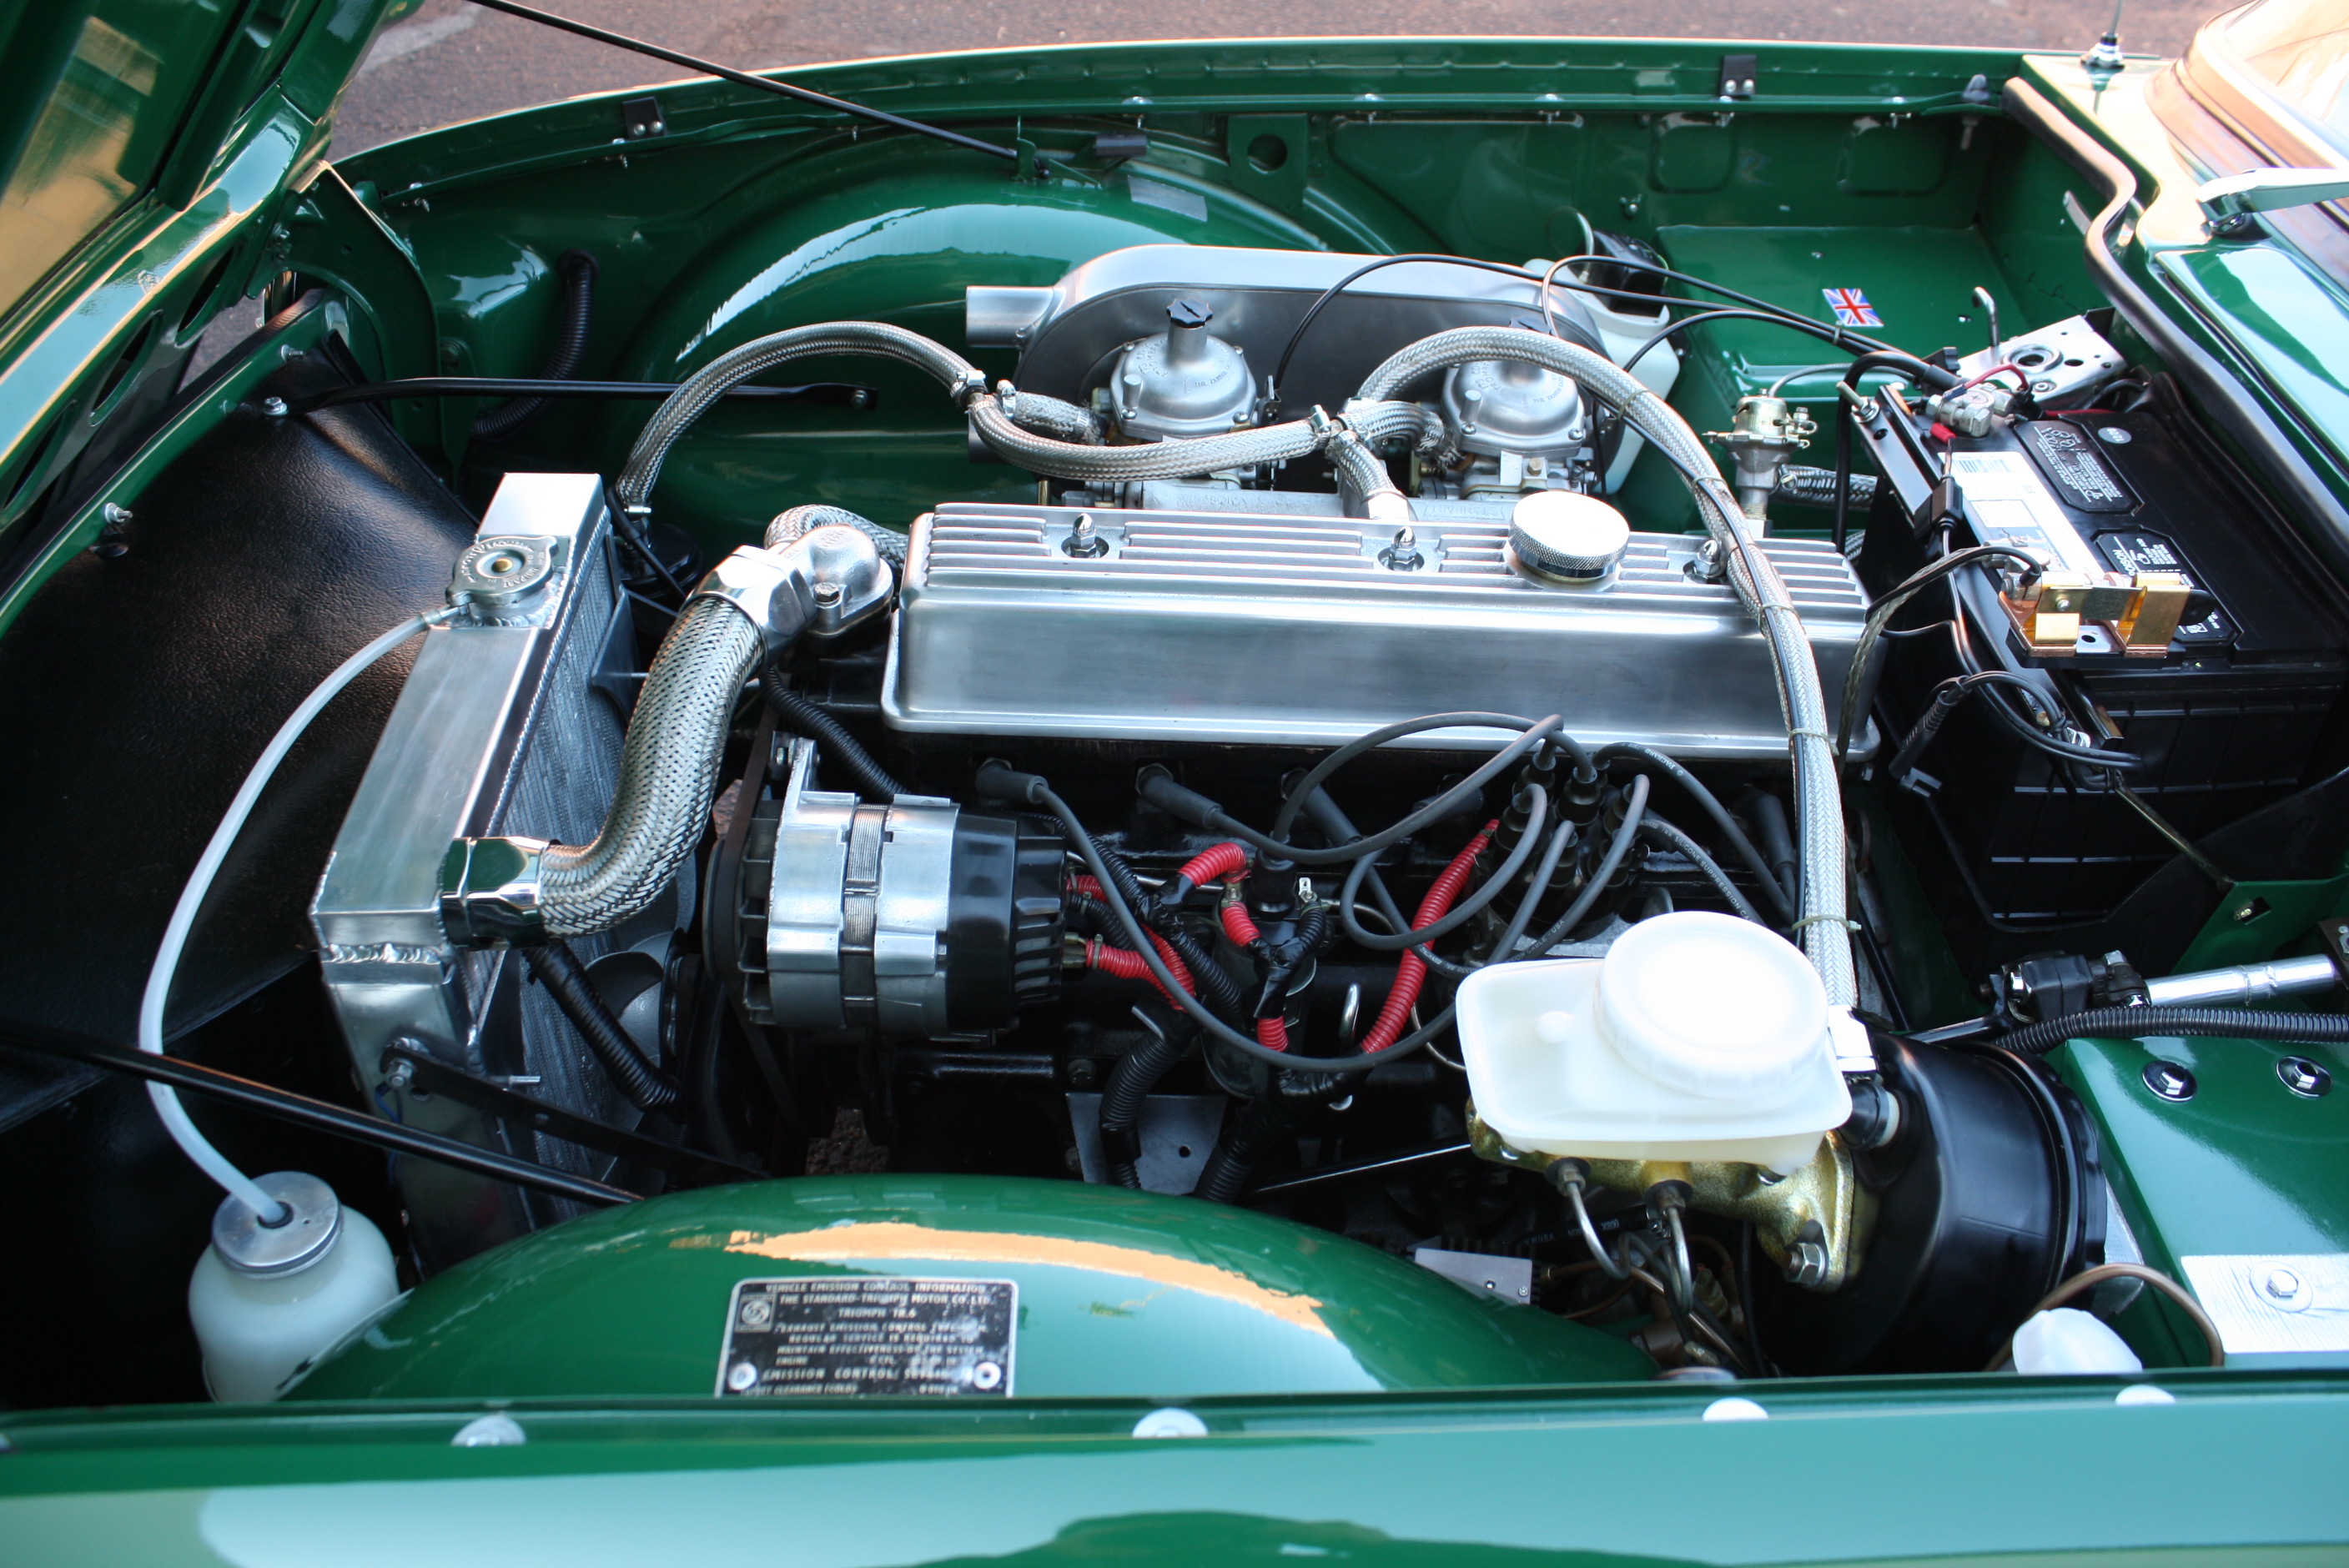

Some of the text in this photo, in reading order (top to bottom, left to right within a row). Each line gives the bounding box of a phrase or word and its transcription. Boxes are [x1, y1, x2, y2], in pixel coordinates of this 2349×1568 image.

[2112, 549, 2136, 576] POISON
[1644, 748, 1677, 770] PACKARD
[1674, 836, 1702, 862] SILICONE
[1700, 860, 1742, 910] SUPPRESSION
[1551, 919, 1566, 933] USA
[766, 1282, 986, 1293] VEHICLE EMISSION CONTROL INFORMATION
[780, 1294, 799, 1304] THE
[911, 1294, 948, 1304] MOTOR
[838, 1307, 888, 1319] TRIUMPH
[829, 1323, 878, 1333] EMISSION
[882, 1323, 927, 1333] CONTROL
[788, 1334, 837, 1344] REGULAR
[843, 1334, 885, 1344] SERVICE
[888, 1334, 900, 1343] IS
[903, 1334, 957, 1344] REQUIRED
[777, 1344, 827, 1355] MAINTAIN
[828, 1344, 904, 1354] EFFECTIVENESS
[776, 1355, 809, 1366] ENGINE
[762, 1368, 826, 1381] EMISSION
[774, 1384, 823, 1395] CLEARANCE
